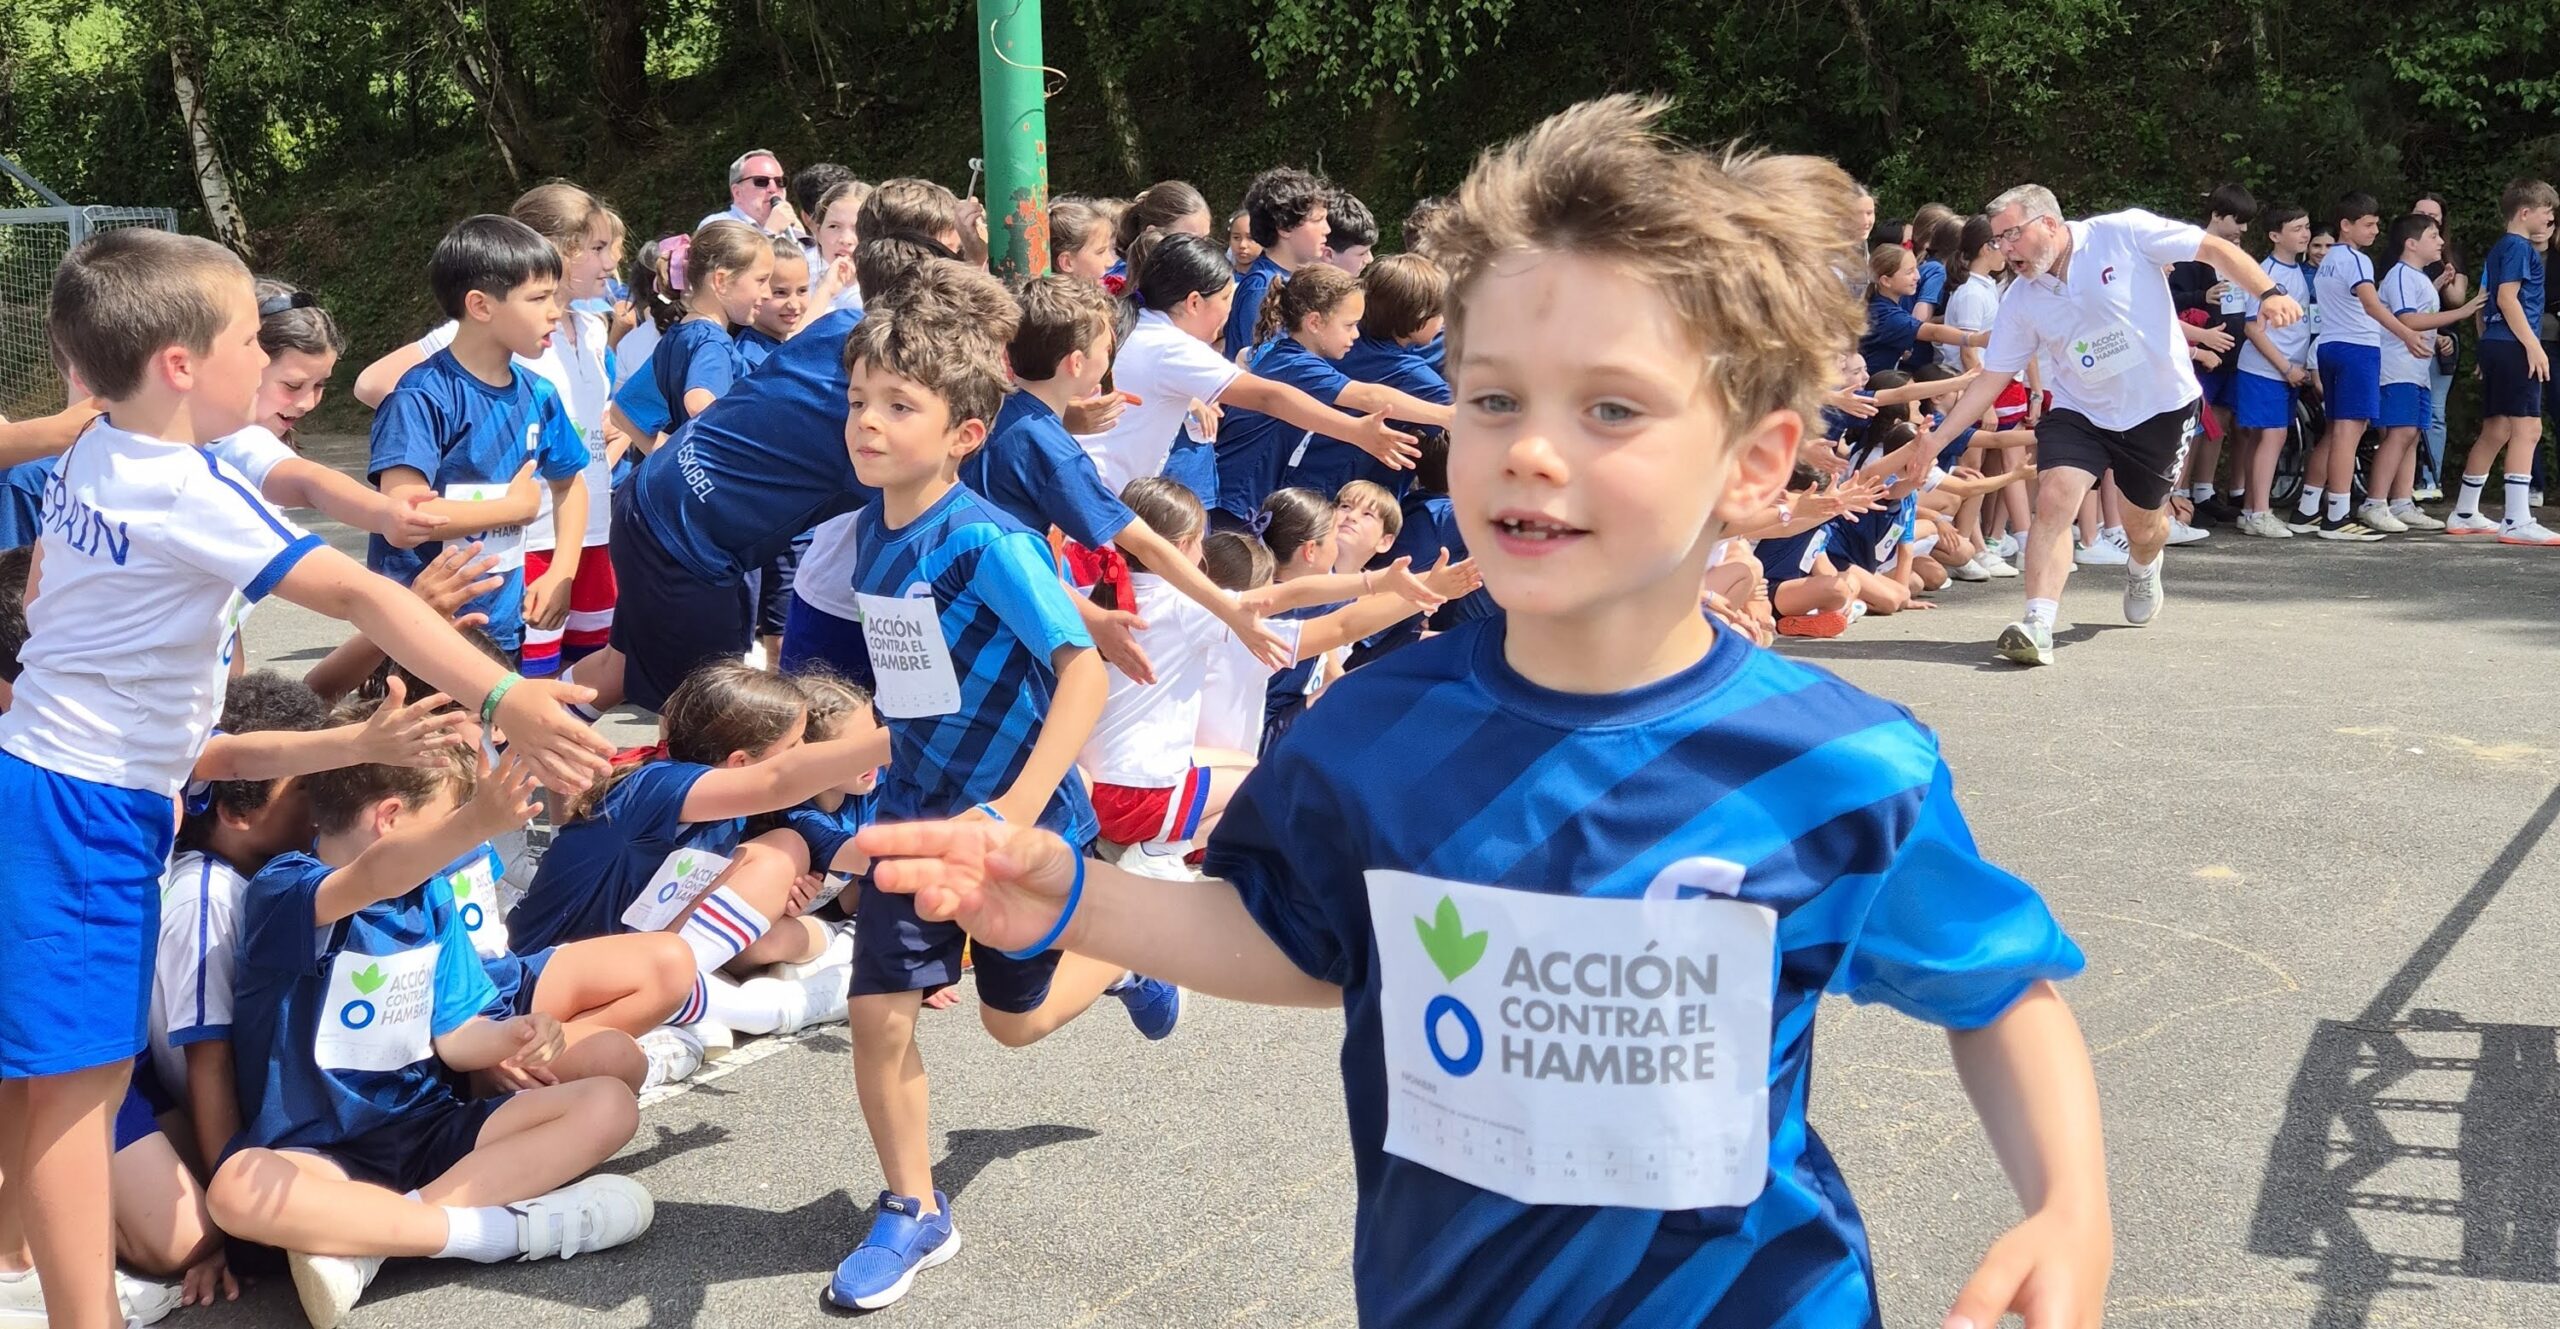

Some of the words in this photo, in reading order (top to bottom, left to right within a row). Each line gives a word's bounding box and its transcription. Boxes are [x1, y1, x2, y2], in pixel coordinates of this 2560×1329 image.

[677, 442, 715, 503] ESKIBEL
[868, 614, 923, 638] ACCIÓN
[869, 636, 910, 653] CONTRA
[911, 639, 927, 653] EL
[871, 653, 932, 671] HAMBRE
[1502, 939, 1718, 1000] ACCIÓN
[1500, 996, 1669, 1038] CONTRA
[1678, 1004, 1715, 1036] EL
[1501, 1034, 1715, 1085] HAMBRE
